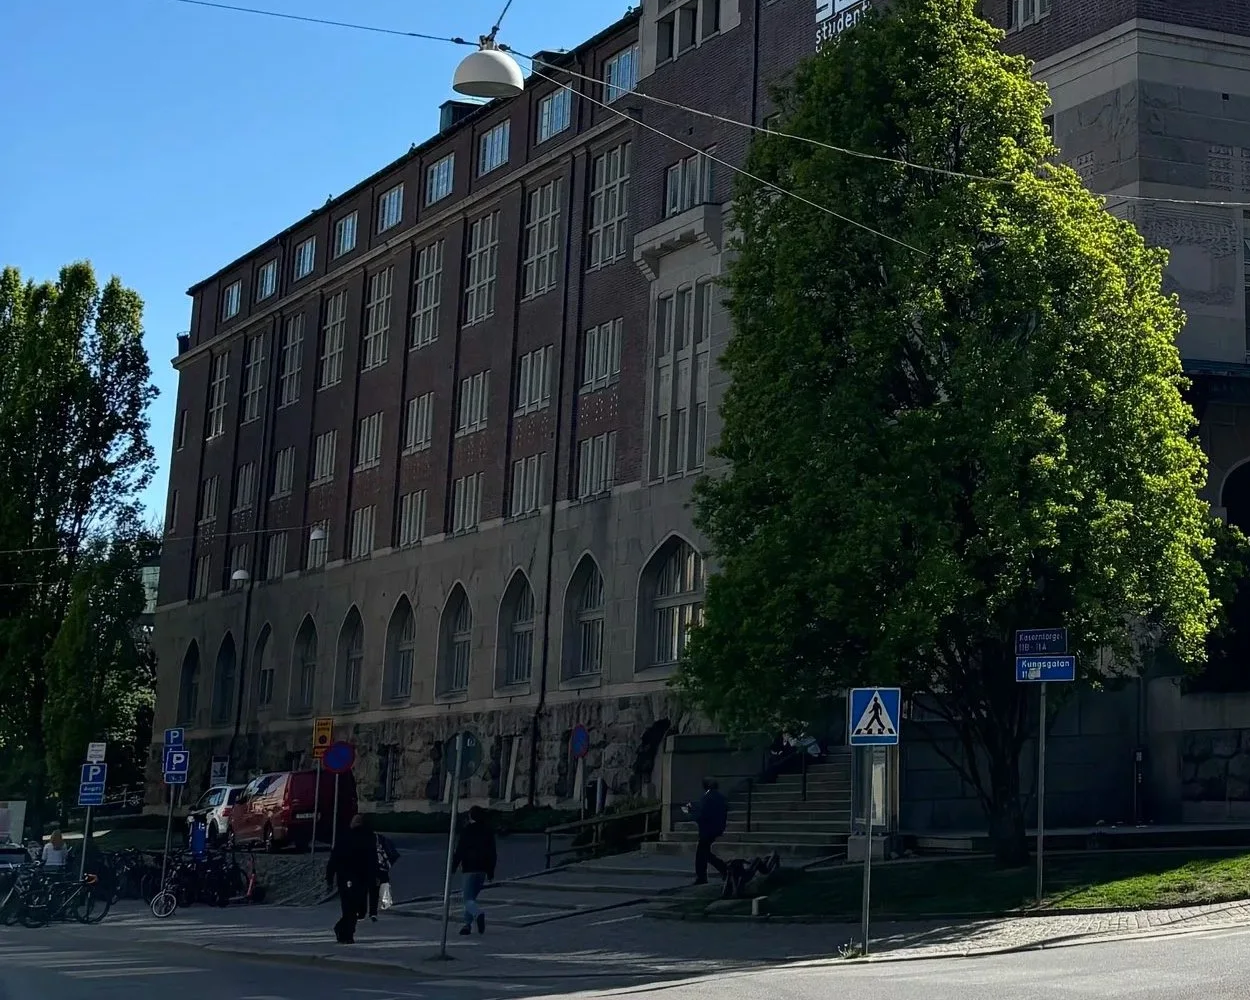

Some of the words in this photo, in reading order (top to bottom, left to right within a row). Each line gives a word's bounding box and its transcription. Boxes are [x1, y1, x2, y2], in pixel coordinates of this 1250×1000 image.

[1021, 659, 1070, 669] Kungsgatan
[170, 730, 180, 744] P
[172, 753, 185, 770] P
[89, 766, 101, 782] P
